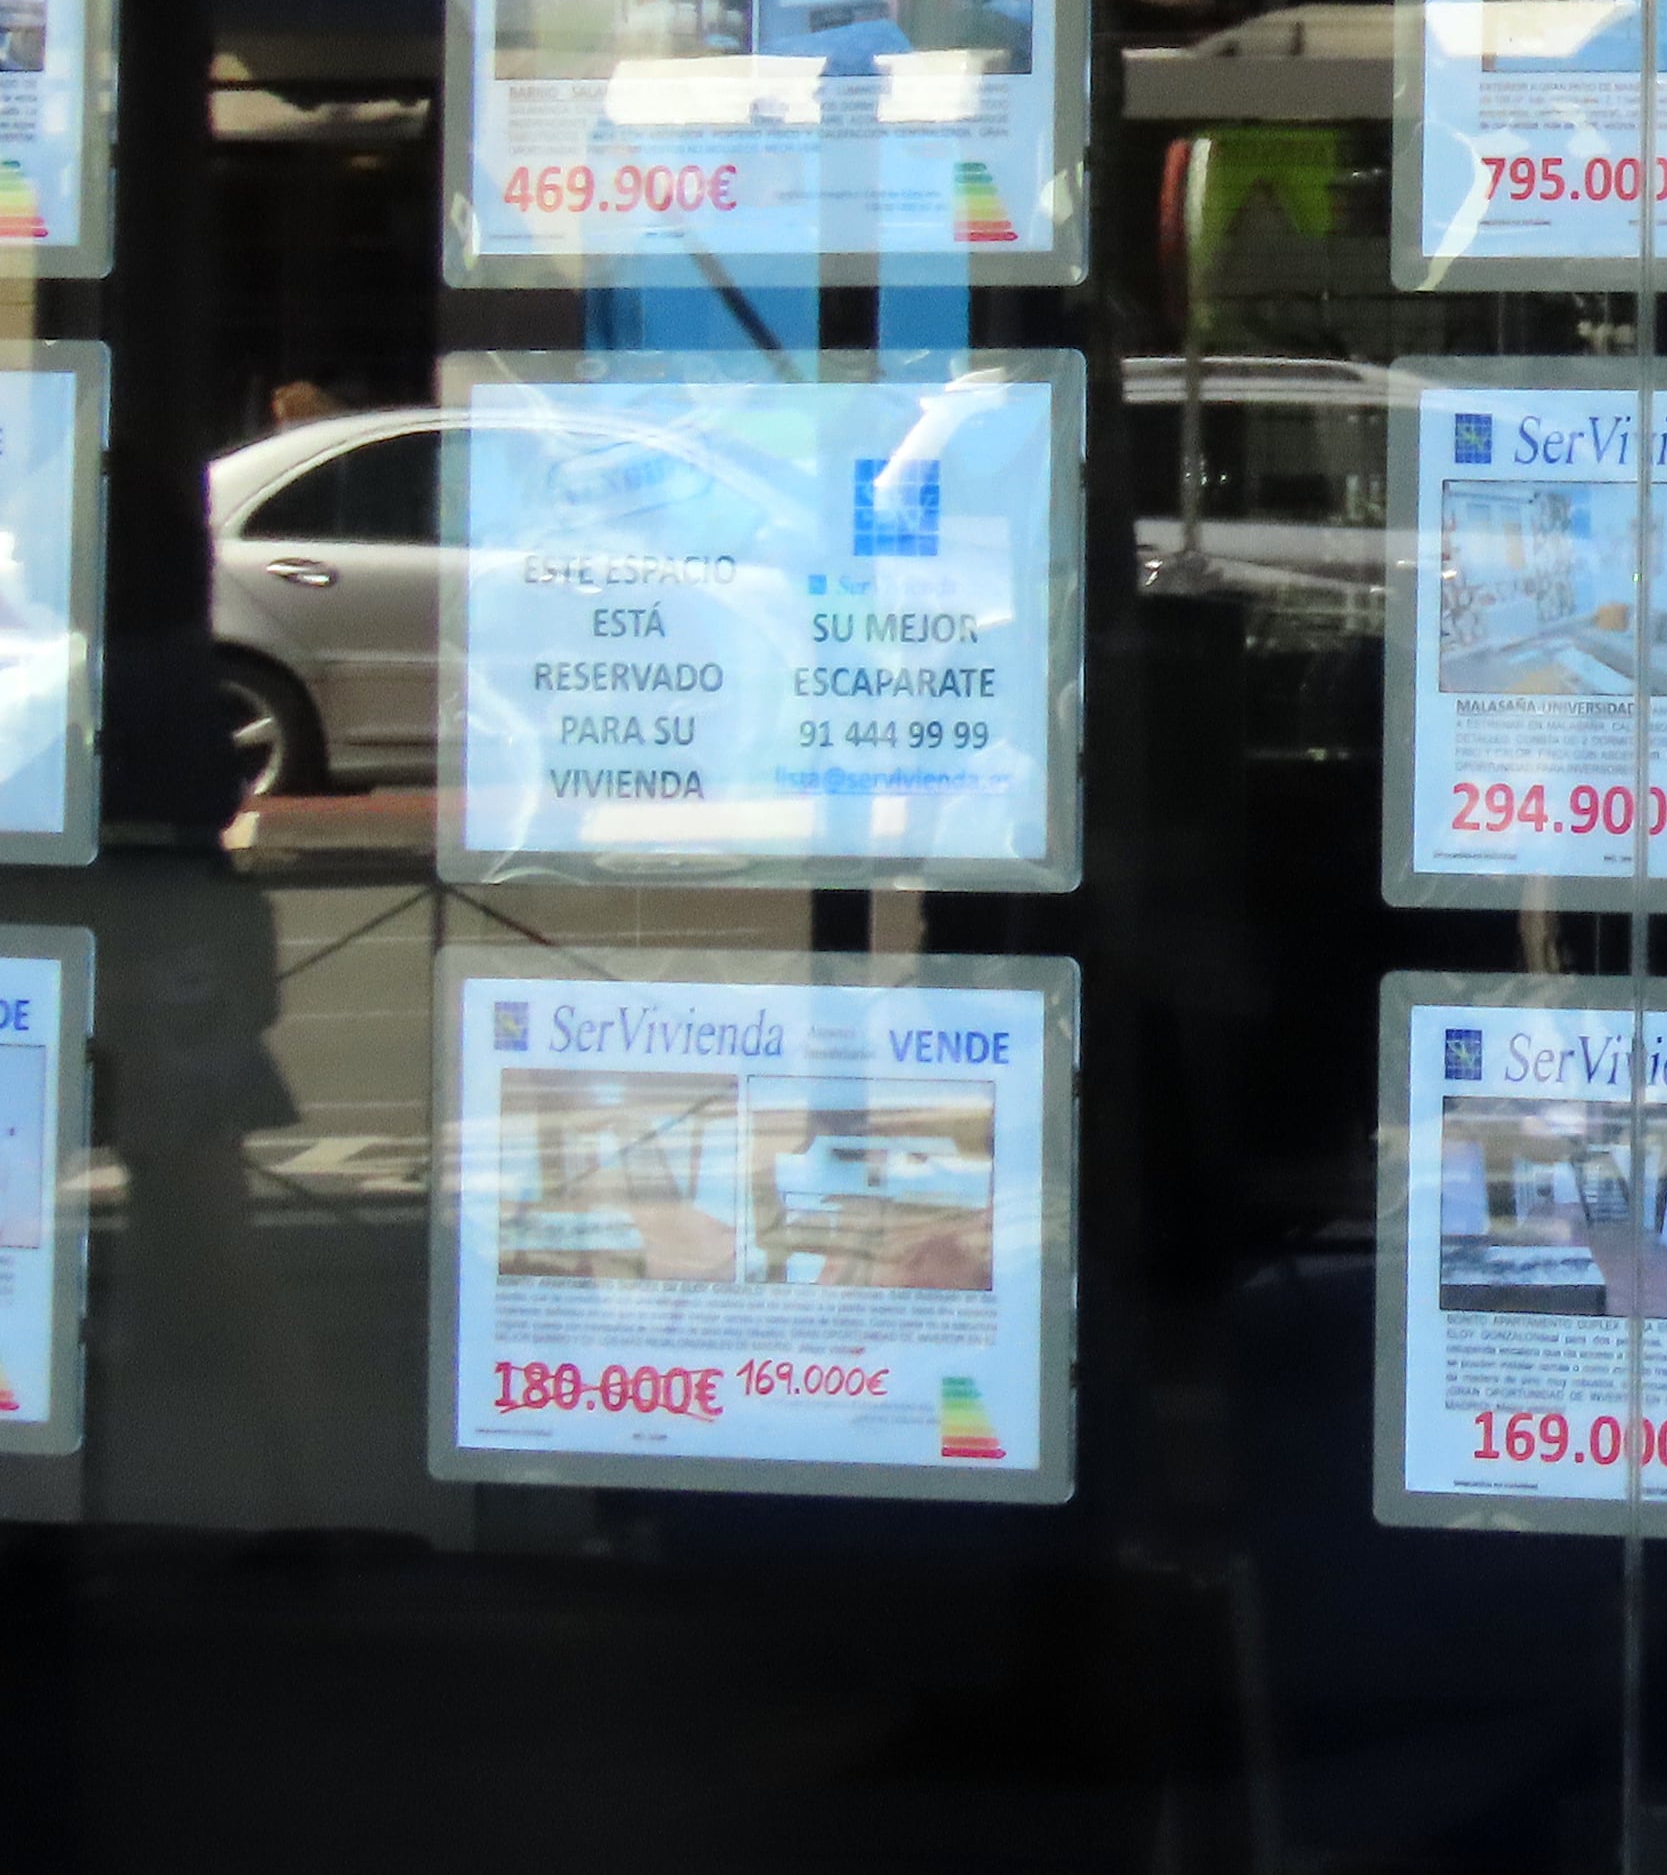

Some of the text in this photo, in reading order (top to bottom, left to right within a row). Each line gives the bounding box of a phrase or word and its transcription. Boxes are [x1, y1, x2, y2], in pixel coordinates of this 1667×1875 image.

[503, 163, 739, 214] 469.900€
[605, 554, 737, 584] ESPACIO
[592, 602, 664, 638] ESTÁ
[812, 612, 979, 644] SU MEJOR
[534, 662, 724, 693] RESERVADO
[792, 667, 996, 698] ESCAPARATE
[560, 717, 696, 746] PARA SU
[799, 720, 990, 749] 91 444 99 99
[550, 768, 705, 800] VIVIENDA
[548, 1004, 1011, 1065] SerVivienda VENDE
[493, 1361, 725, 1416] 180.000€
[736, 1359, 891, 1398] 169.000€
